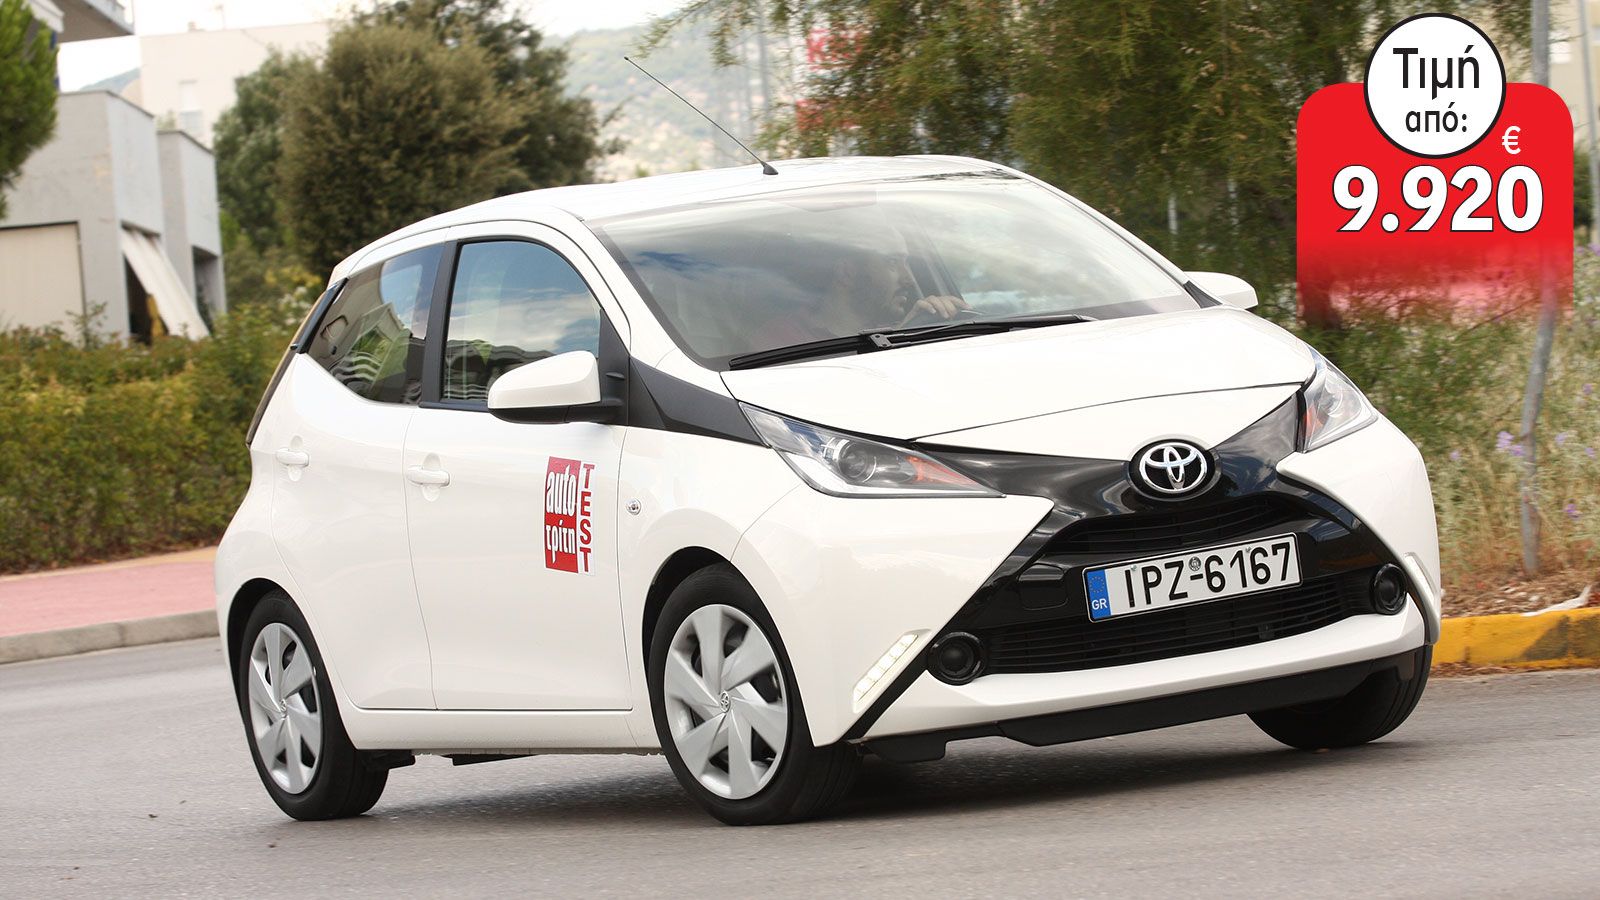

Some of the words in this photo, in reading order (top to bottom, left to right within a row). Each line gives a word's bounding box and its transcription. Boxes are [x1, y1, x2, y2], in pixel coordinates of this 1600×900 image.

[546, 464, 577, 517] auto
[579, 463, 595, 573] TEST
[1091, 598, 1108, 611] GR
